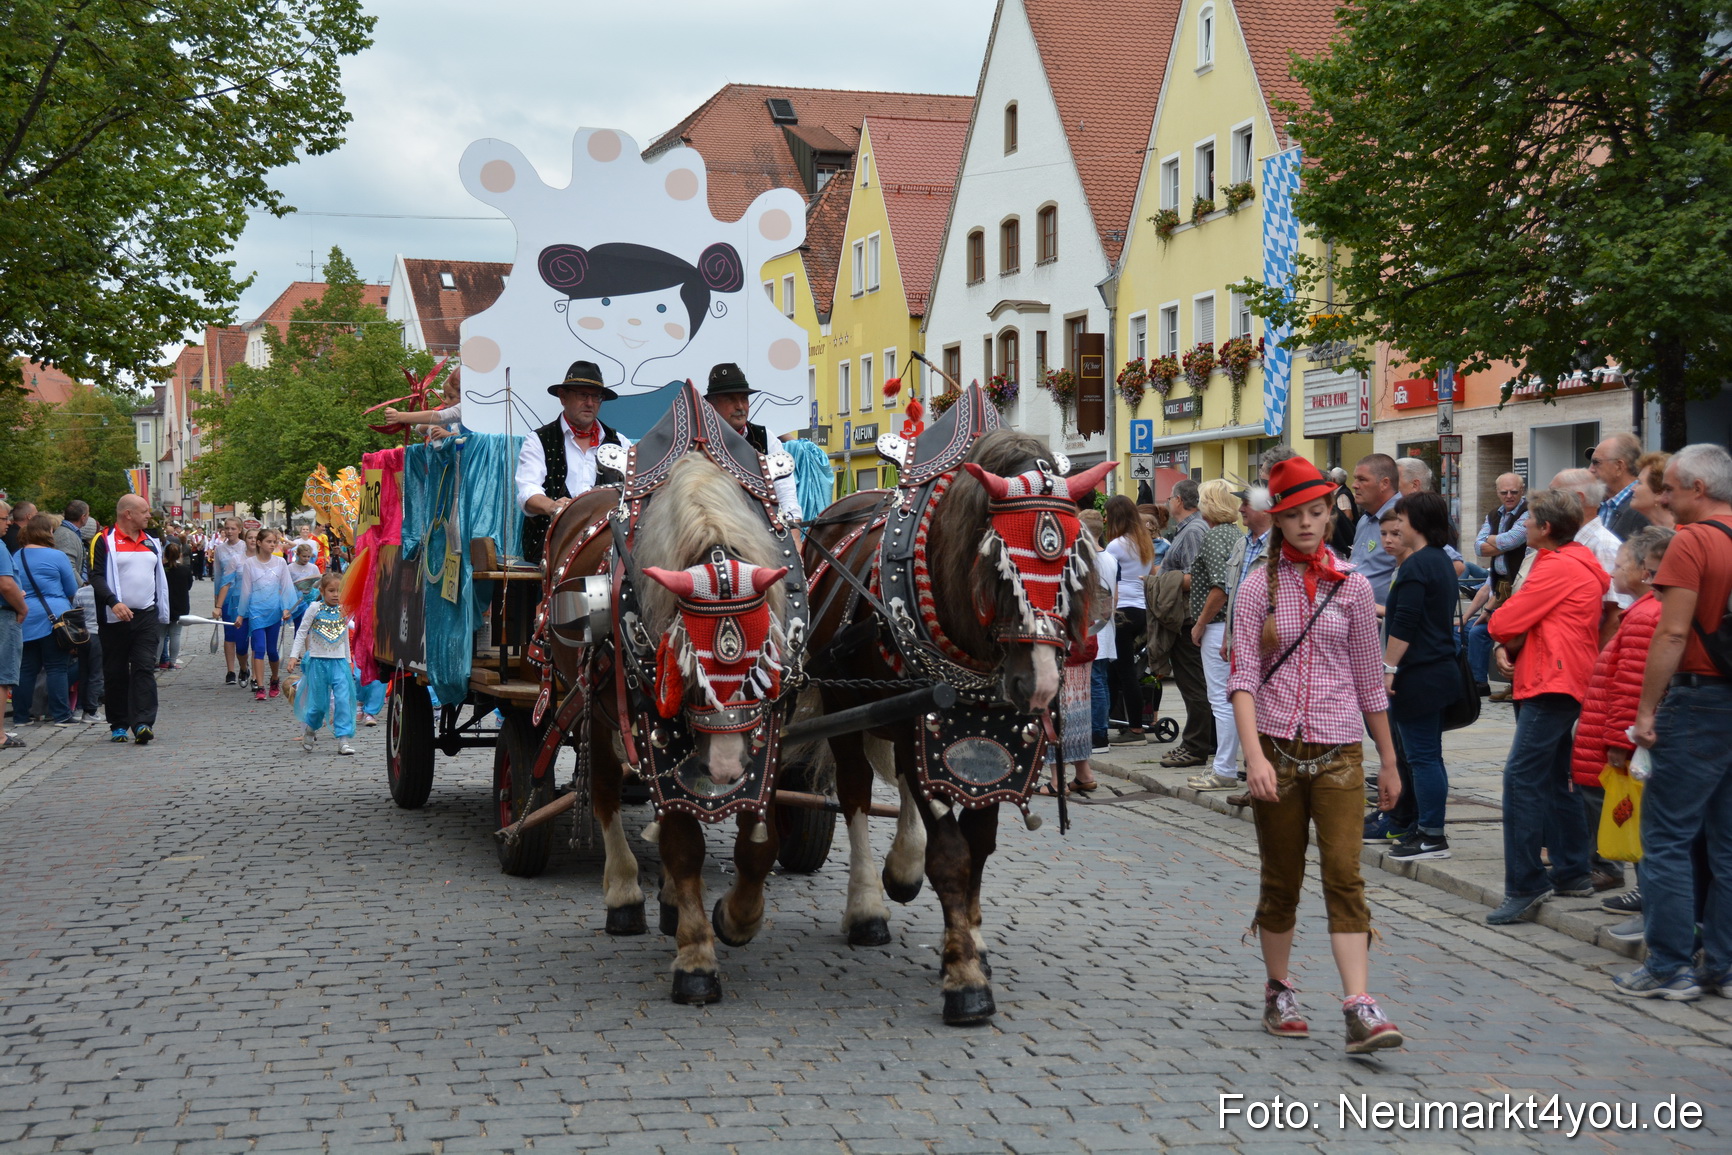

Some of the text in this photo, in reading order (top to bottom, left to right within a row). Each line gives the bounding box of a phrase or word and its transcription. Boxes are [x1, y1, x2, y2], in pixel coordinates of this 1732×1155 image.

[1334, 392, 1348, 406] KINO
[1165, 404, 1179, 415] WOLLE
[1183, 401, 1195, 412] MEH
[1135, 424, 1148, 450] P
